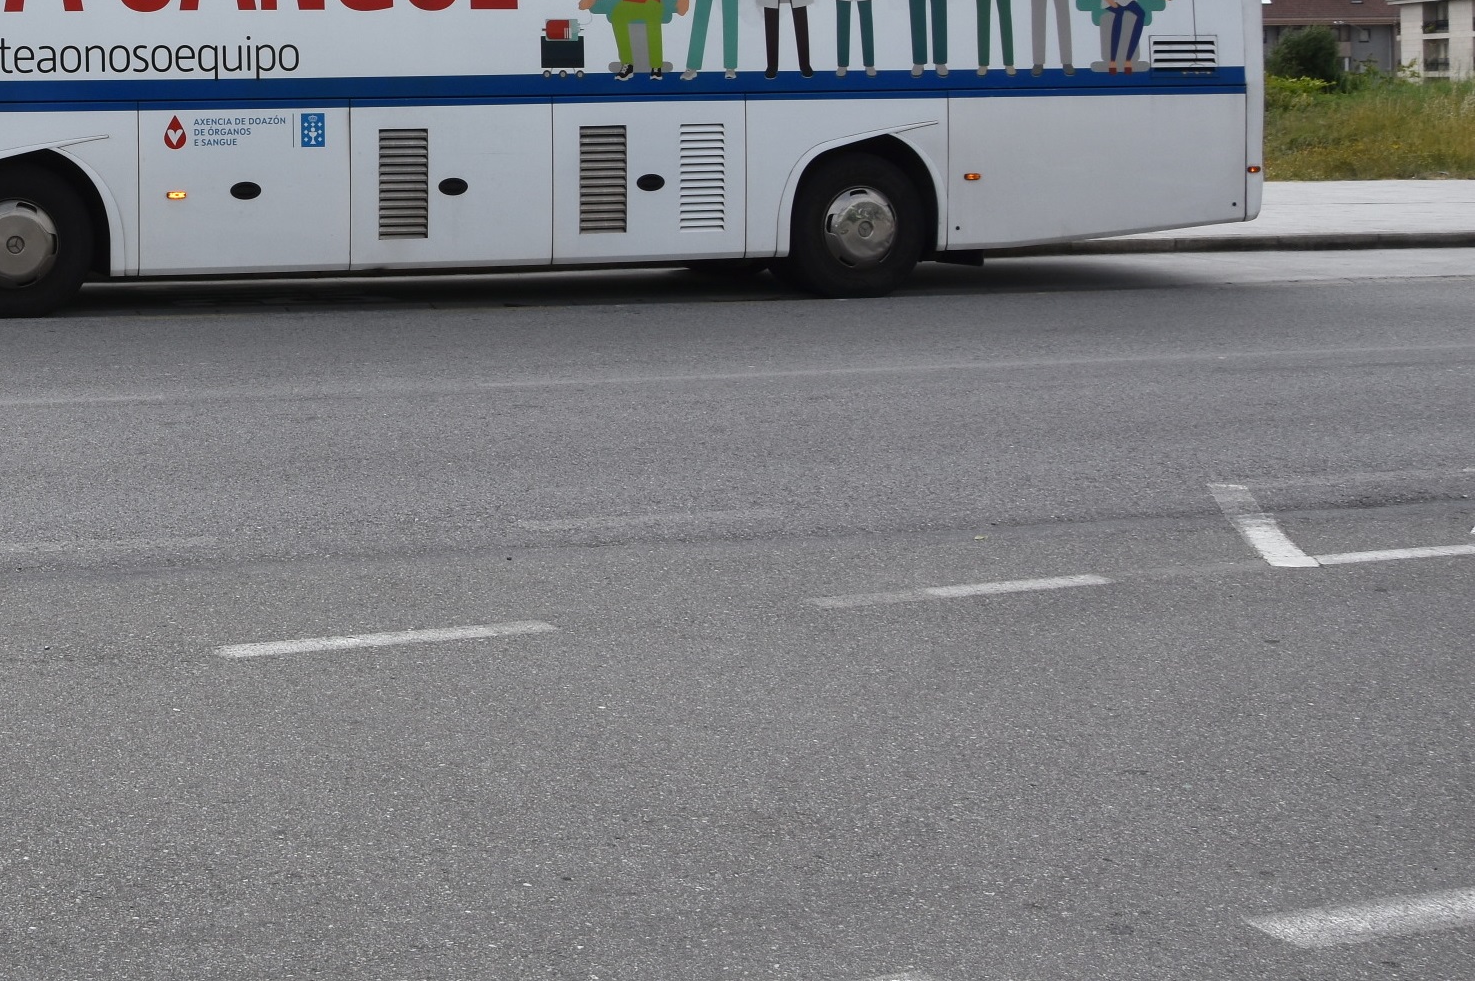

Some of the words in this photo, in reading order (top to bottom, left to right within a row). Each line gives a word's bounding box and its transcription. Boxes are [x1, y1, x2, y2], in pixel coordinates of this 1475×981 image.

[193, 118, 232, 126] AXENCIA
[248, 115, 286, 125] DOAZÓN
[193, 128, 206, 136] DE
[207, 126, 251, 136] ÓRGANOS
[201, 138, 237, 146] SANGUE
